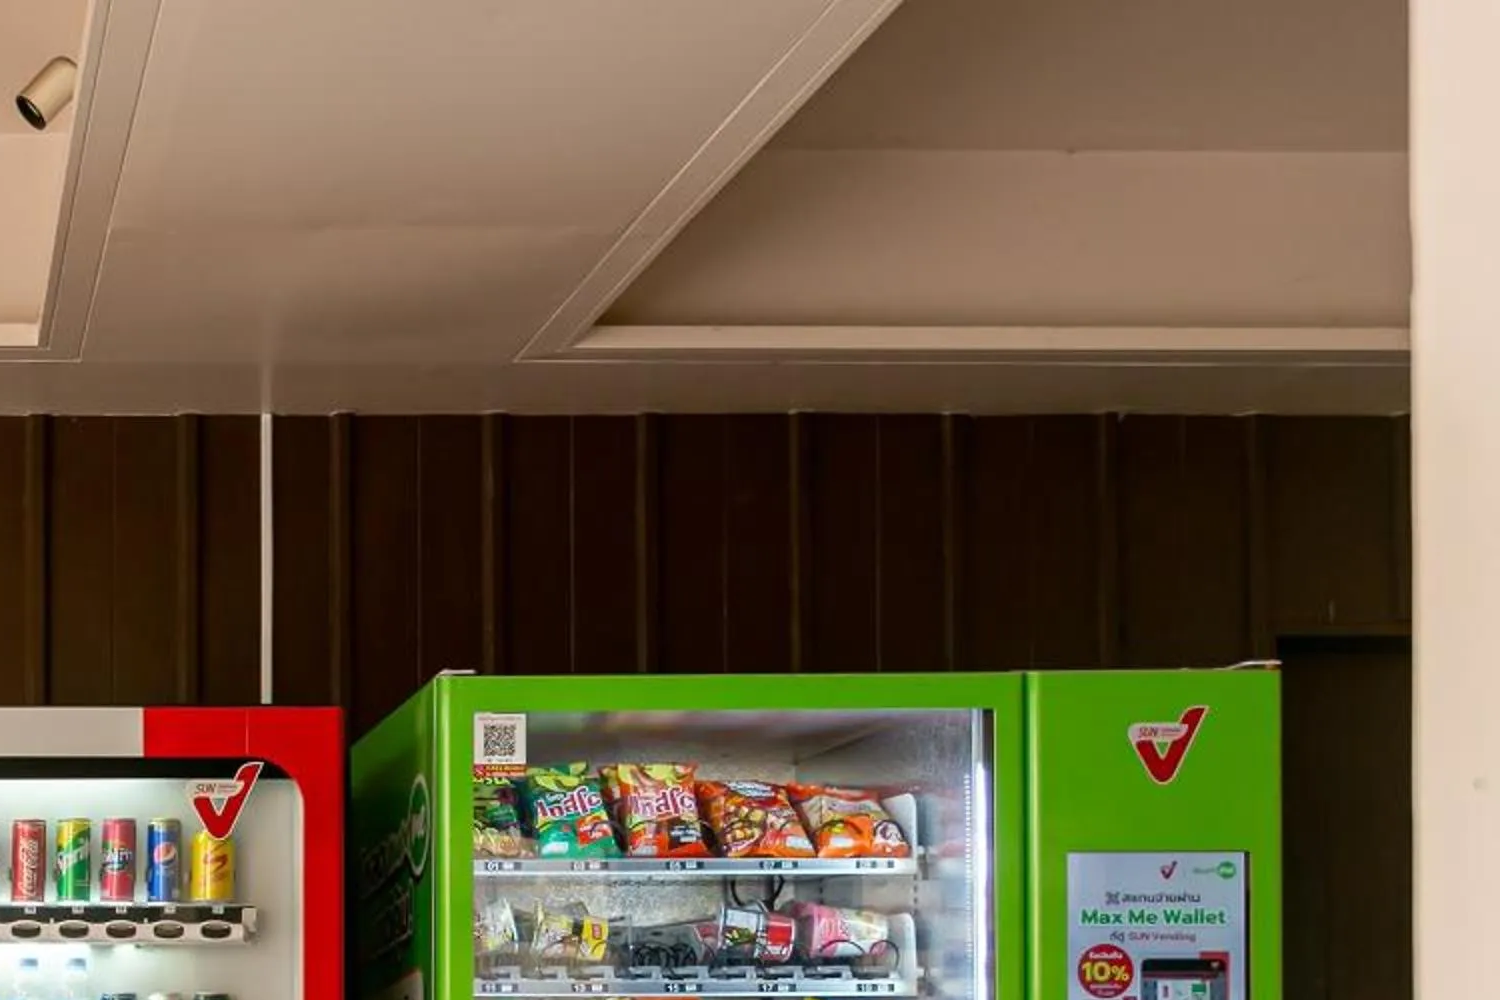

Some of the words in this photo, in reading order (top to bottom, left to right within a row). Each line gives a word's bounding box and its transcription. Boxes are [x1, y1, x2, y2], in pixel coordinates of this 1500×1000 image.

[1081, 908, 1122, 924] Max
[1129, 908, 1158, 924] Me
[1163, 908, 1226, 924] Wallet
[1082, 961, 1130, 982] 10%
